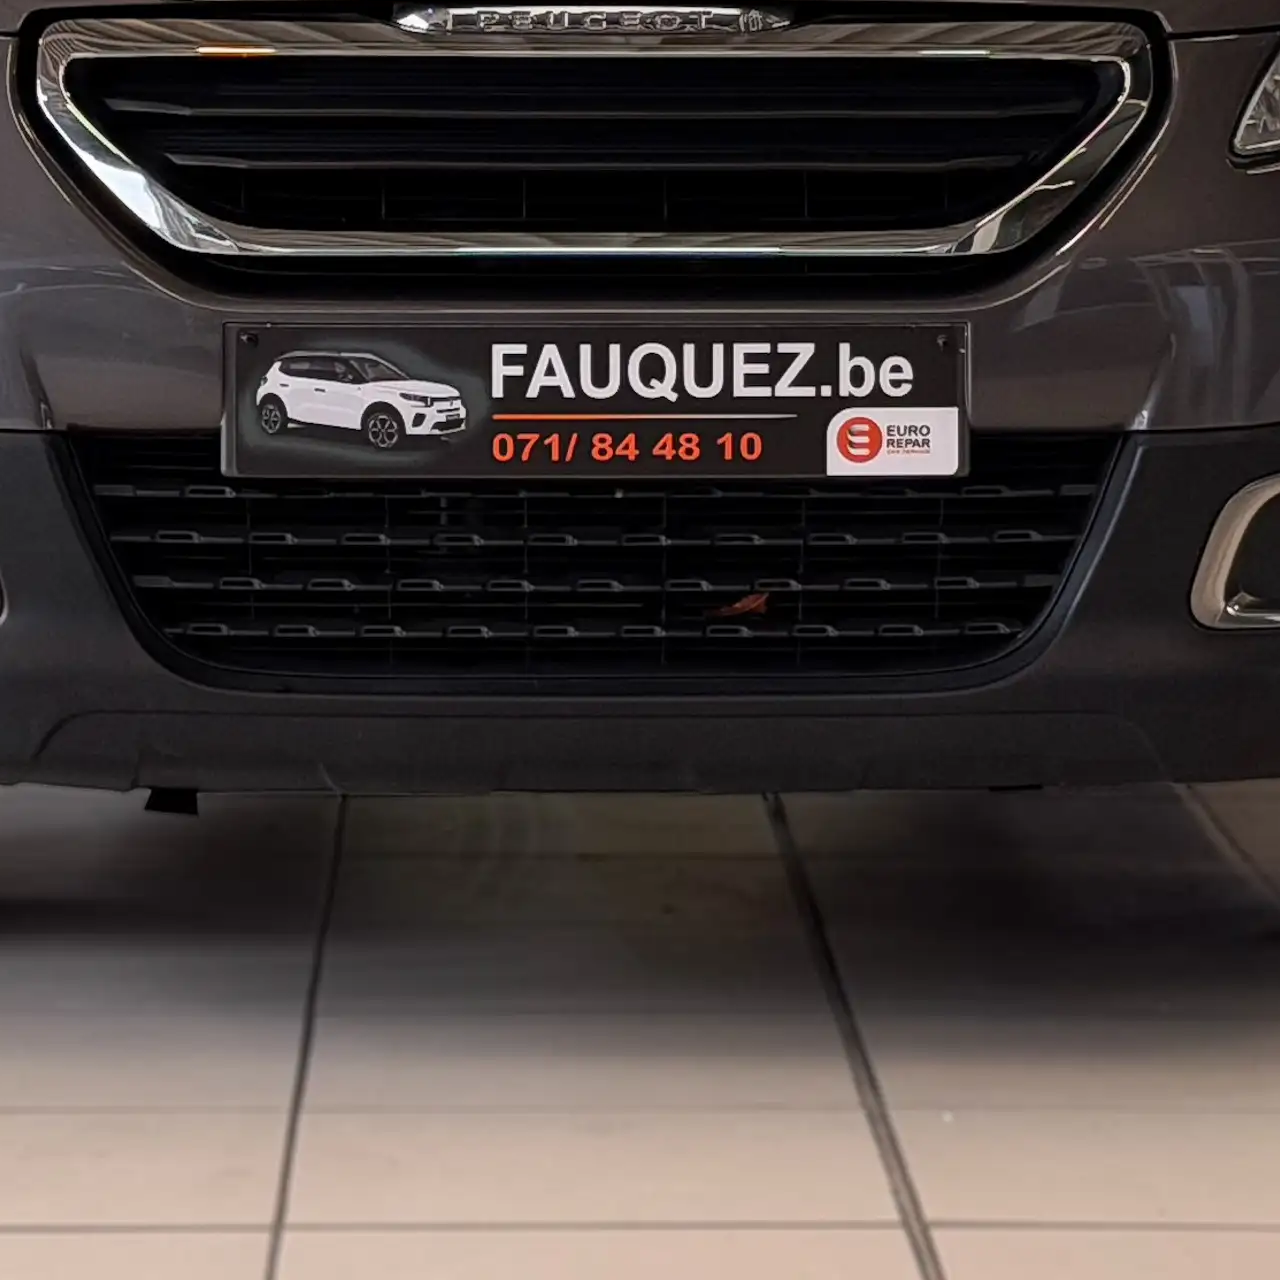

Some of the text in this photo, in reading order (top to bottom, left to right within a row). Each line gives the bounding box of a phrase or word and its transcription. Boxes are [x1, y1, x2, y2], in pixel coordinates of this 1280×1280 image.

[492, 342, 914, 402] FAUQUEZ.be
[886, 424, 931, 437] EURO
[492, 433, 763, 462] 071/ 84 48 10
[886, 438, 931, 449] REPAR
